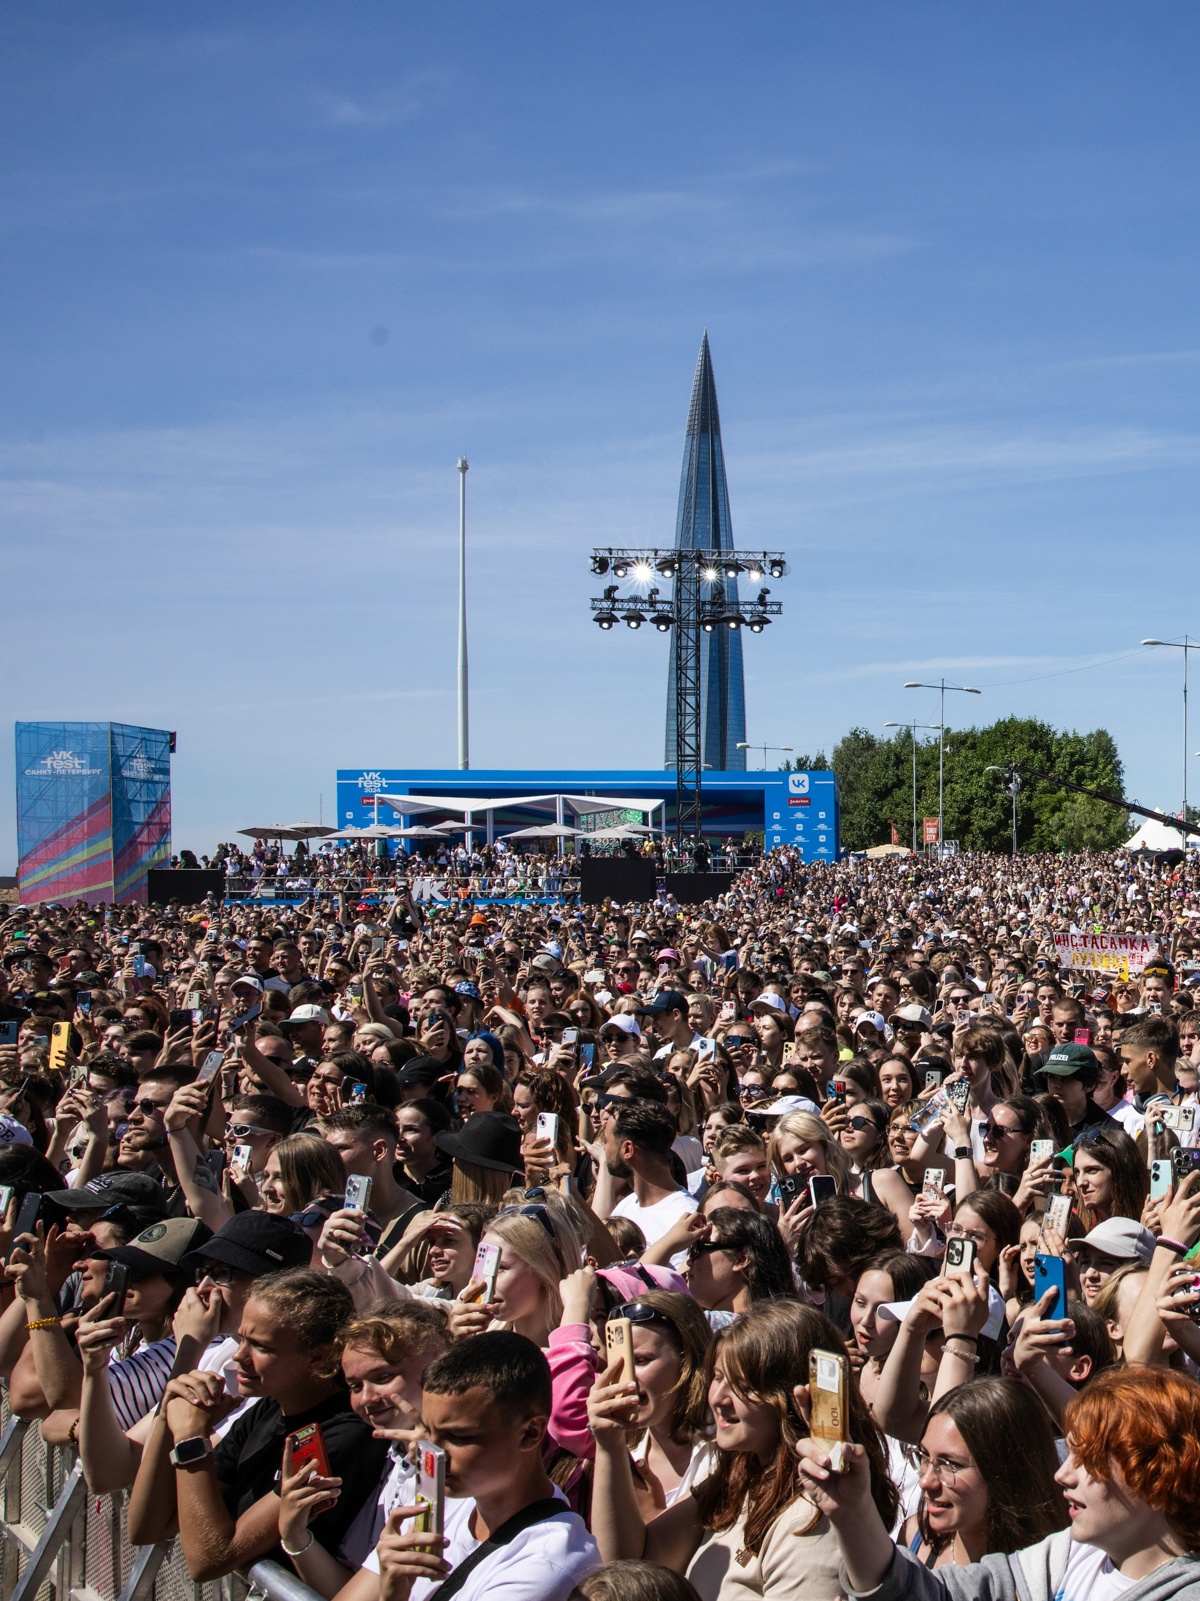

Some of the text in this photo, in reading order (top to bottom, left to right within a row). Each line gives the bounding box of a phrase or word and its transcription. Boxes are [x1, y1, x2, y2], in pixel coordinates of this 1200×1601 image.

[51, 750, 73, 760] VK
[40, 757, 86, 769] fest
[24, 768, 102, 776] САНКТ-ПЕТЕРБУРГ
[363, 771, 382, 780] VK
[358, 777, 389, 788] fest
[792, 779, 806, 788] VK
[1054, 934, 1150, 952] ИНСТАСАМКА
[830, 1405, 840, 1427] 100
